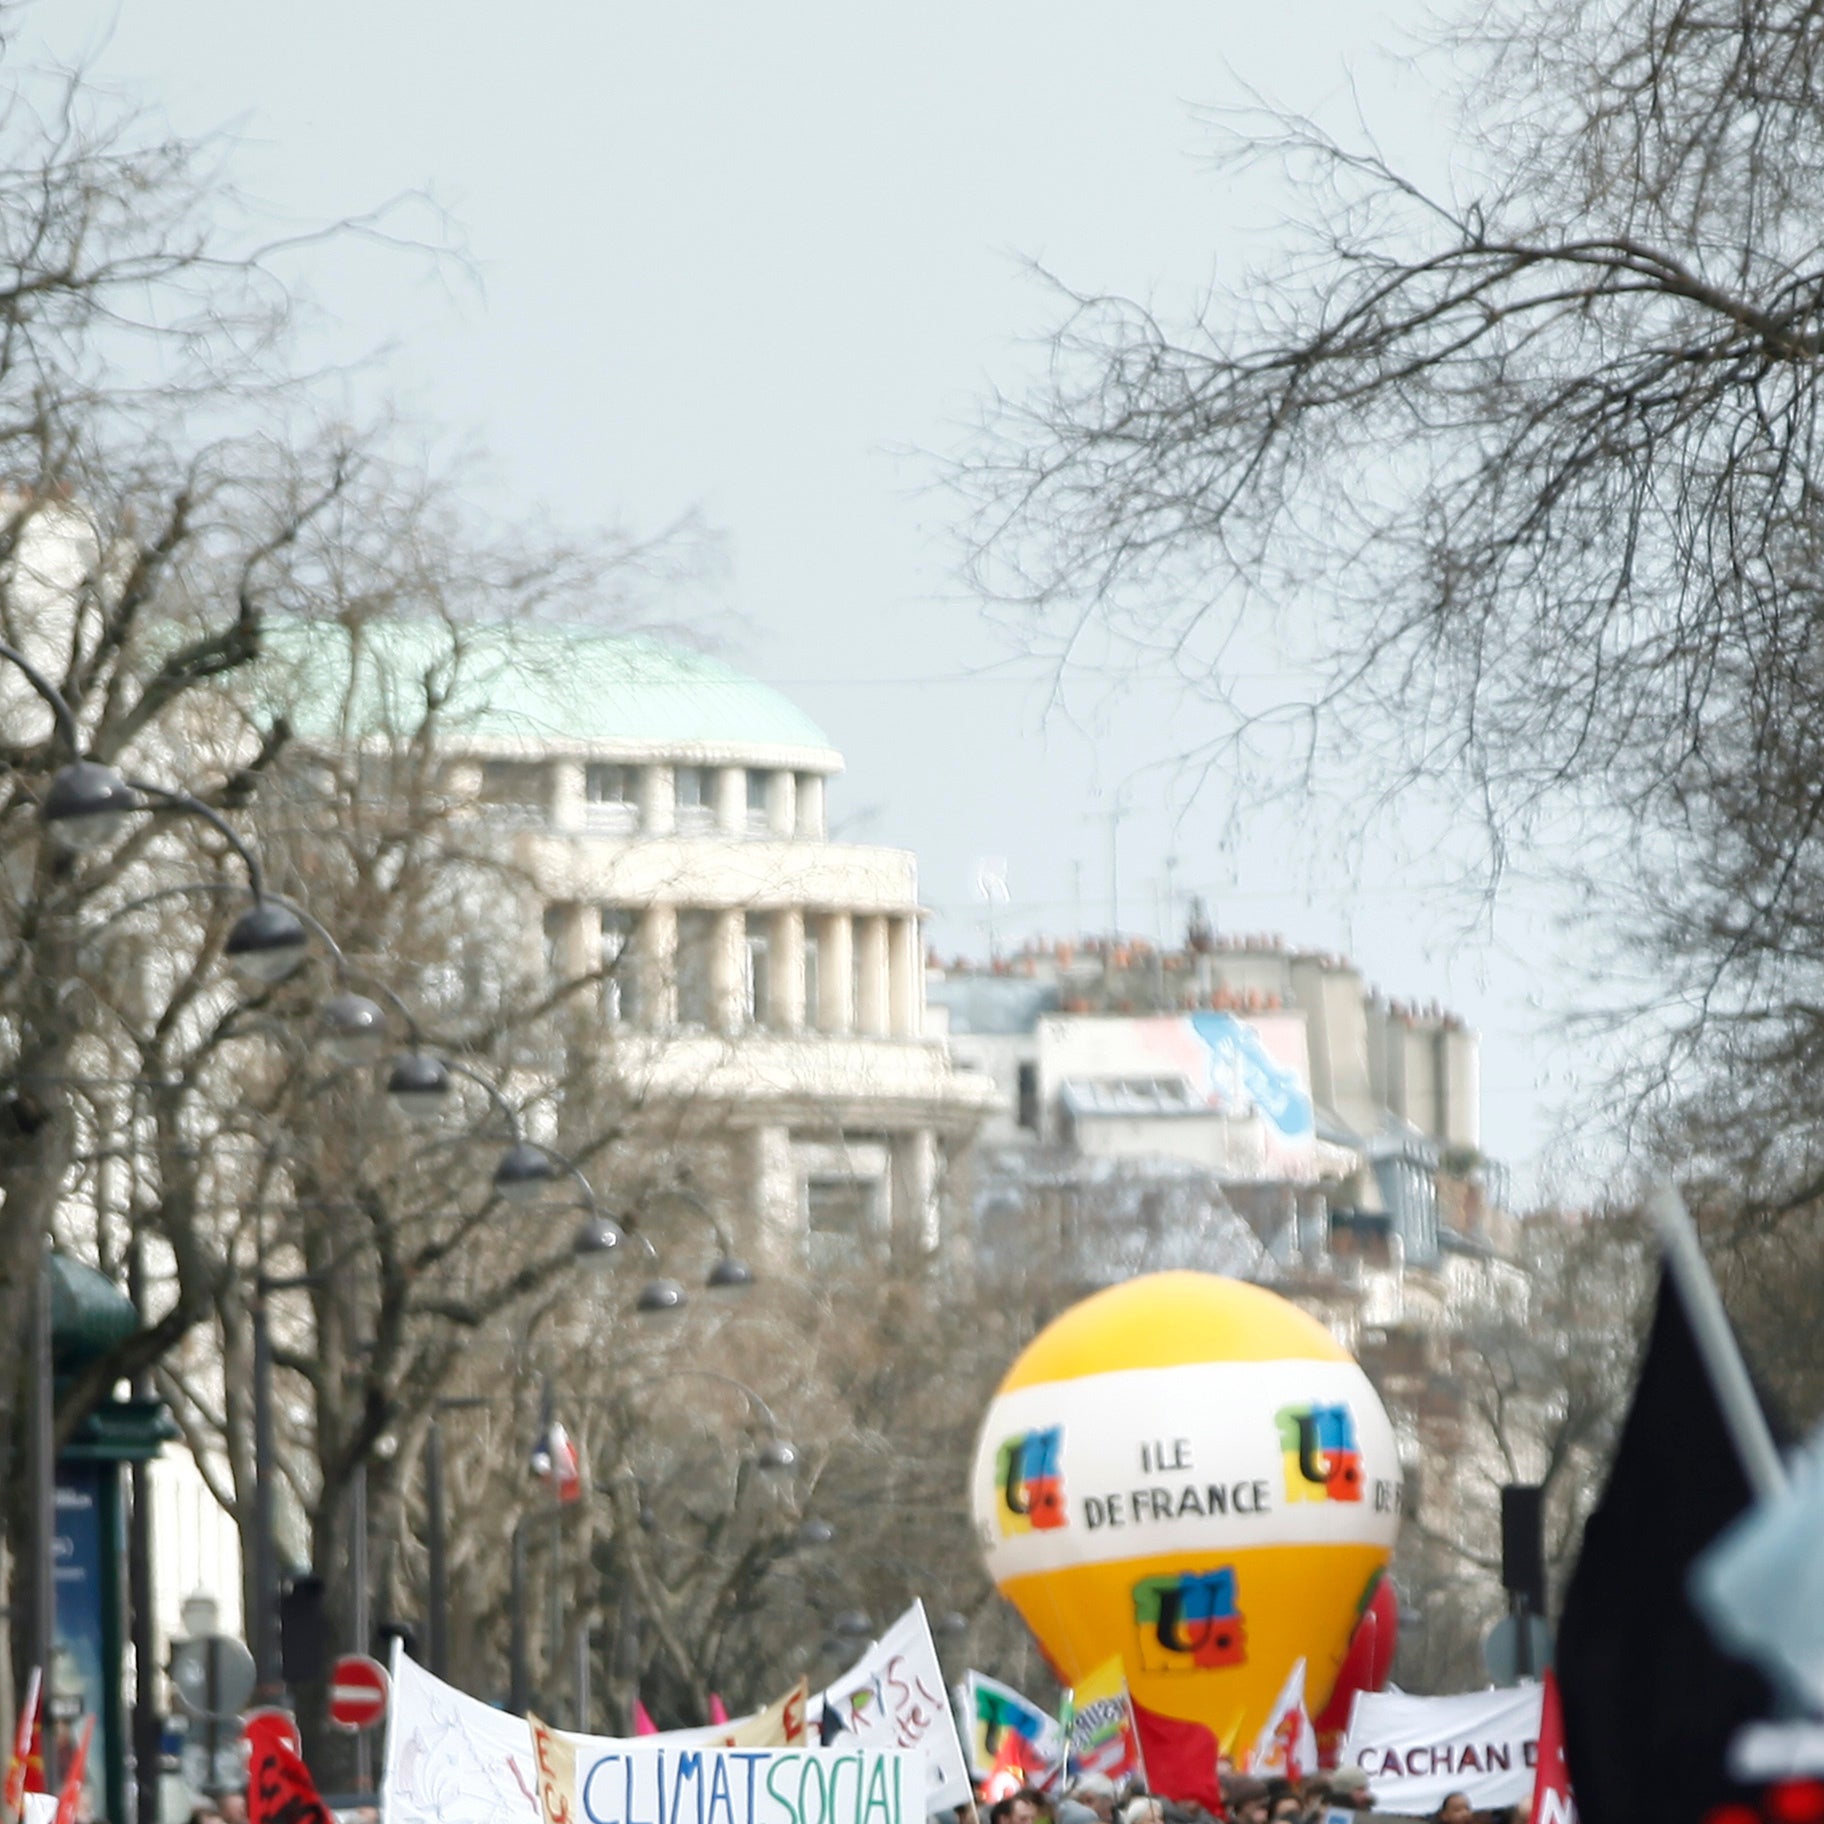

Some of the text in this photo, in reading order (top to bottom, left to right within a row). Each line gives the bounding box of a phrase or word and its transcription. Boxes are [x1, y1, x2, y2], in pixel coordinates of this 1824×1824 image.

[1139, 1438, 1193, 1473] ILE
[1083, 1480, 1273, 1531] DE FRANCE
[1357, 1740, 1511, 1778] CACHAN
